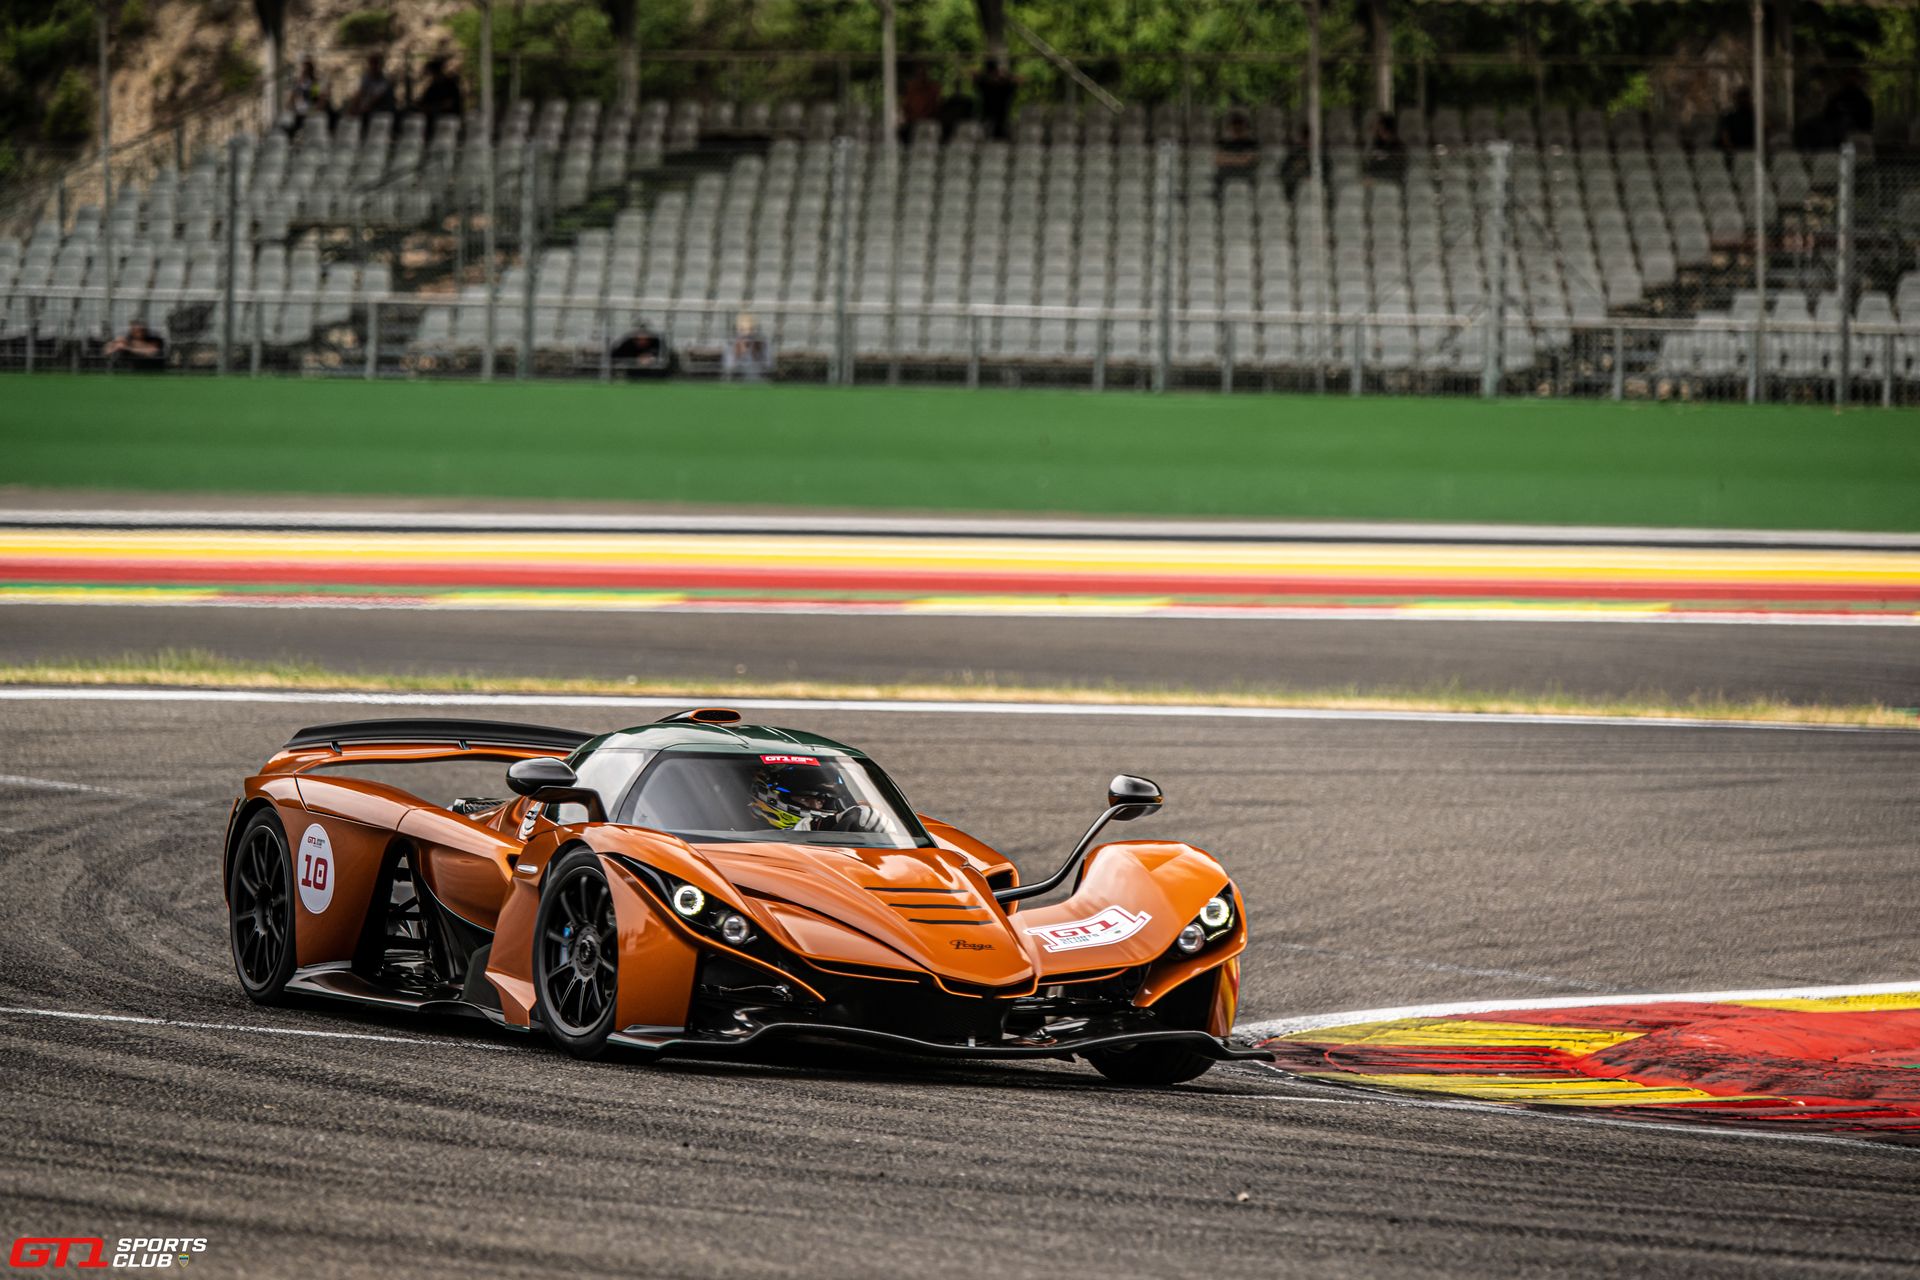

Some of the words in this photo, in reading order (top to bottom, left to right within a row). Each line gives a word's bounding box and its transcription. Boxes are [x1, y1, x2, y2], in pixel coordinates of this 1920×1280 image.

[301, 854, 328, 891] 10
[1049, 920, 1119, 938] GT1
[949, 939, 997, 951] Praga
